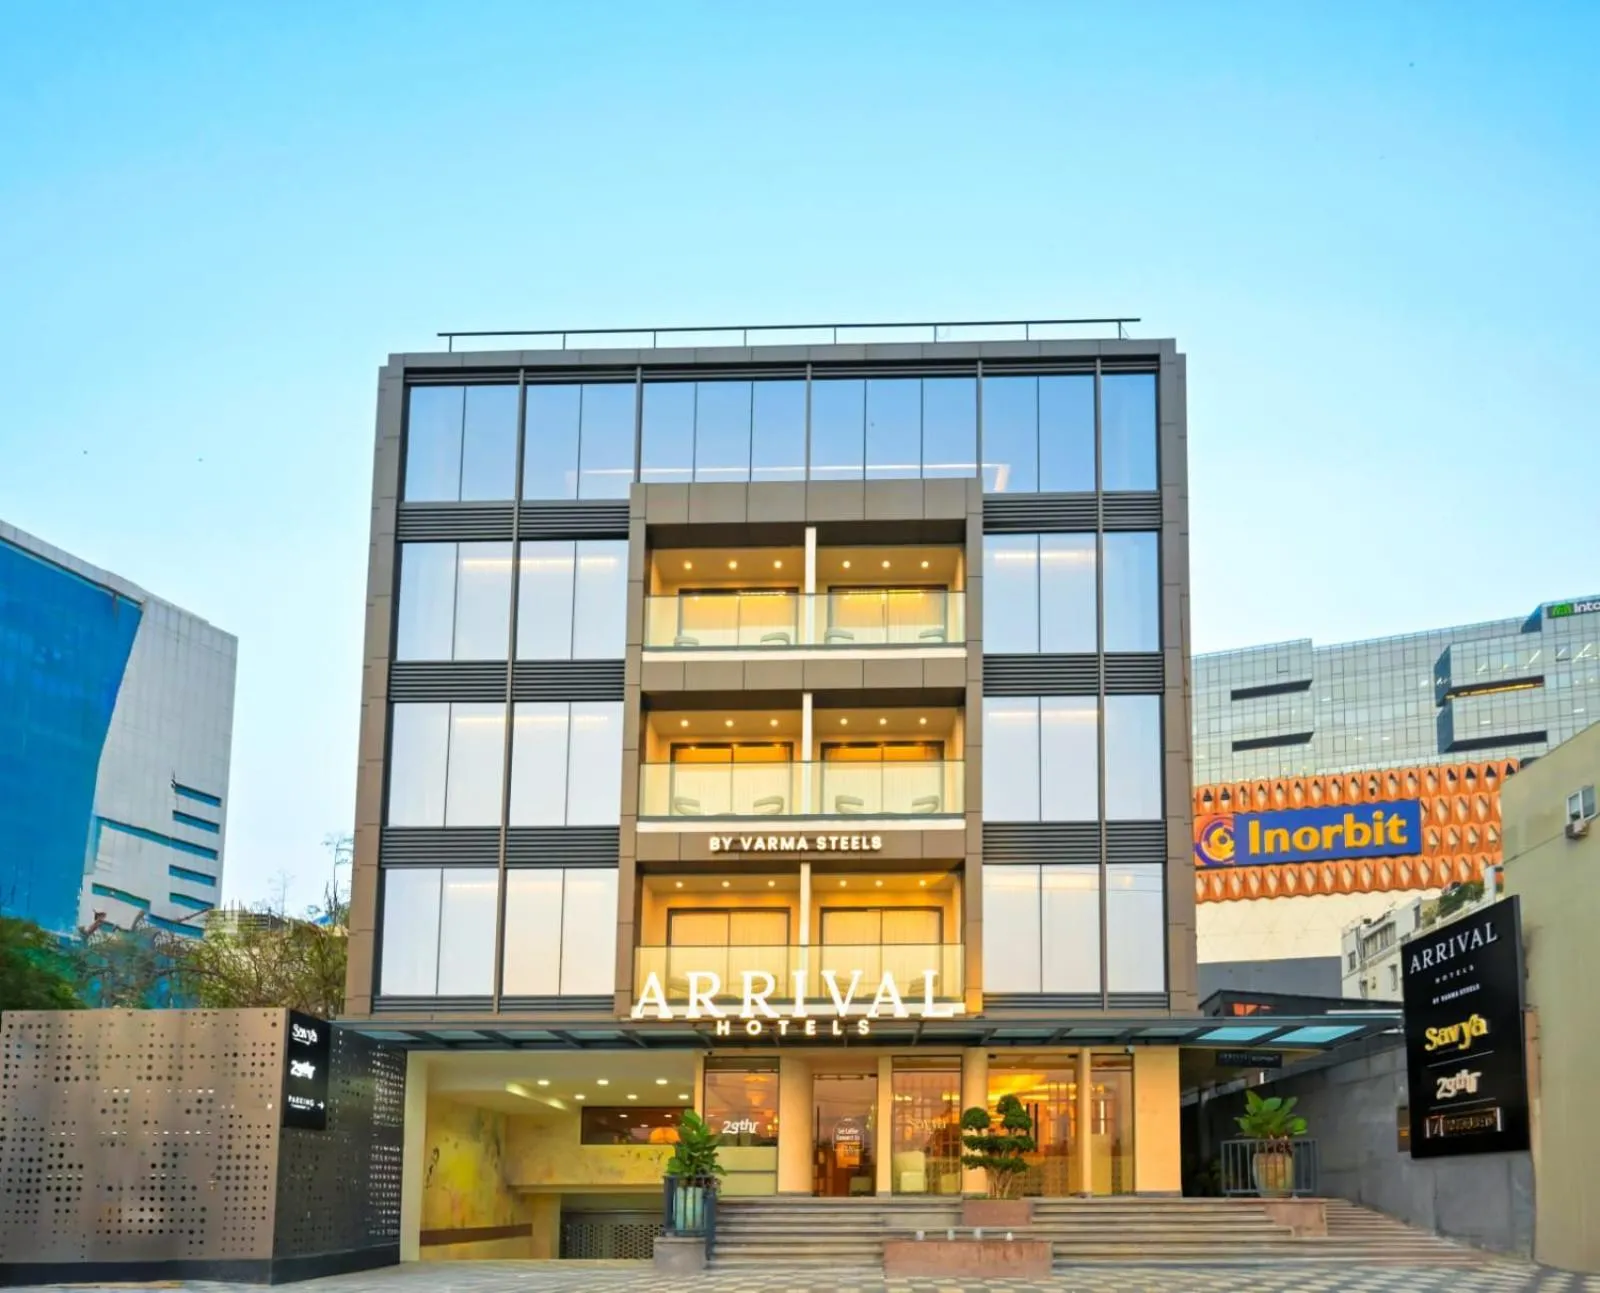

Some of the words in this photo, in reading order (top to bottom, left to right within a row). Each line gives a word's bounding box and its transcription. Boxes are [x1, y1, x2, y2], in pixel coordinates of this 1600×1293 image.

[709, 836, 732, 851] BY
[740, 836, 809, 851] VARMA
[816, 836, 883, 850] STEELS
[1248, 810, 1408, 856] Inorbit
[1409, 921, 1499, 975] ARRIVAL
[630, 970, 955, 1020] ARRIVAL
[716, 1019, 871, 1036] HOTELS
[1424, 1013, 1488, 1051] Savya
